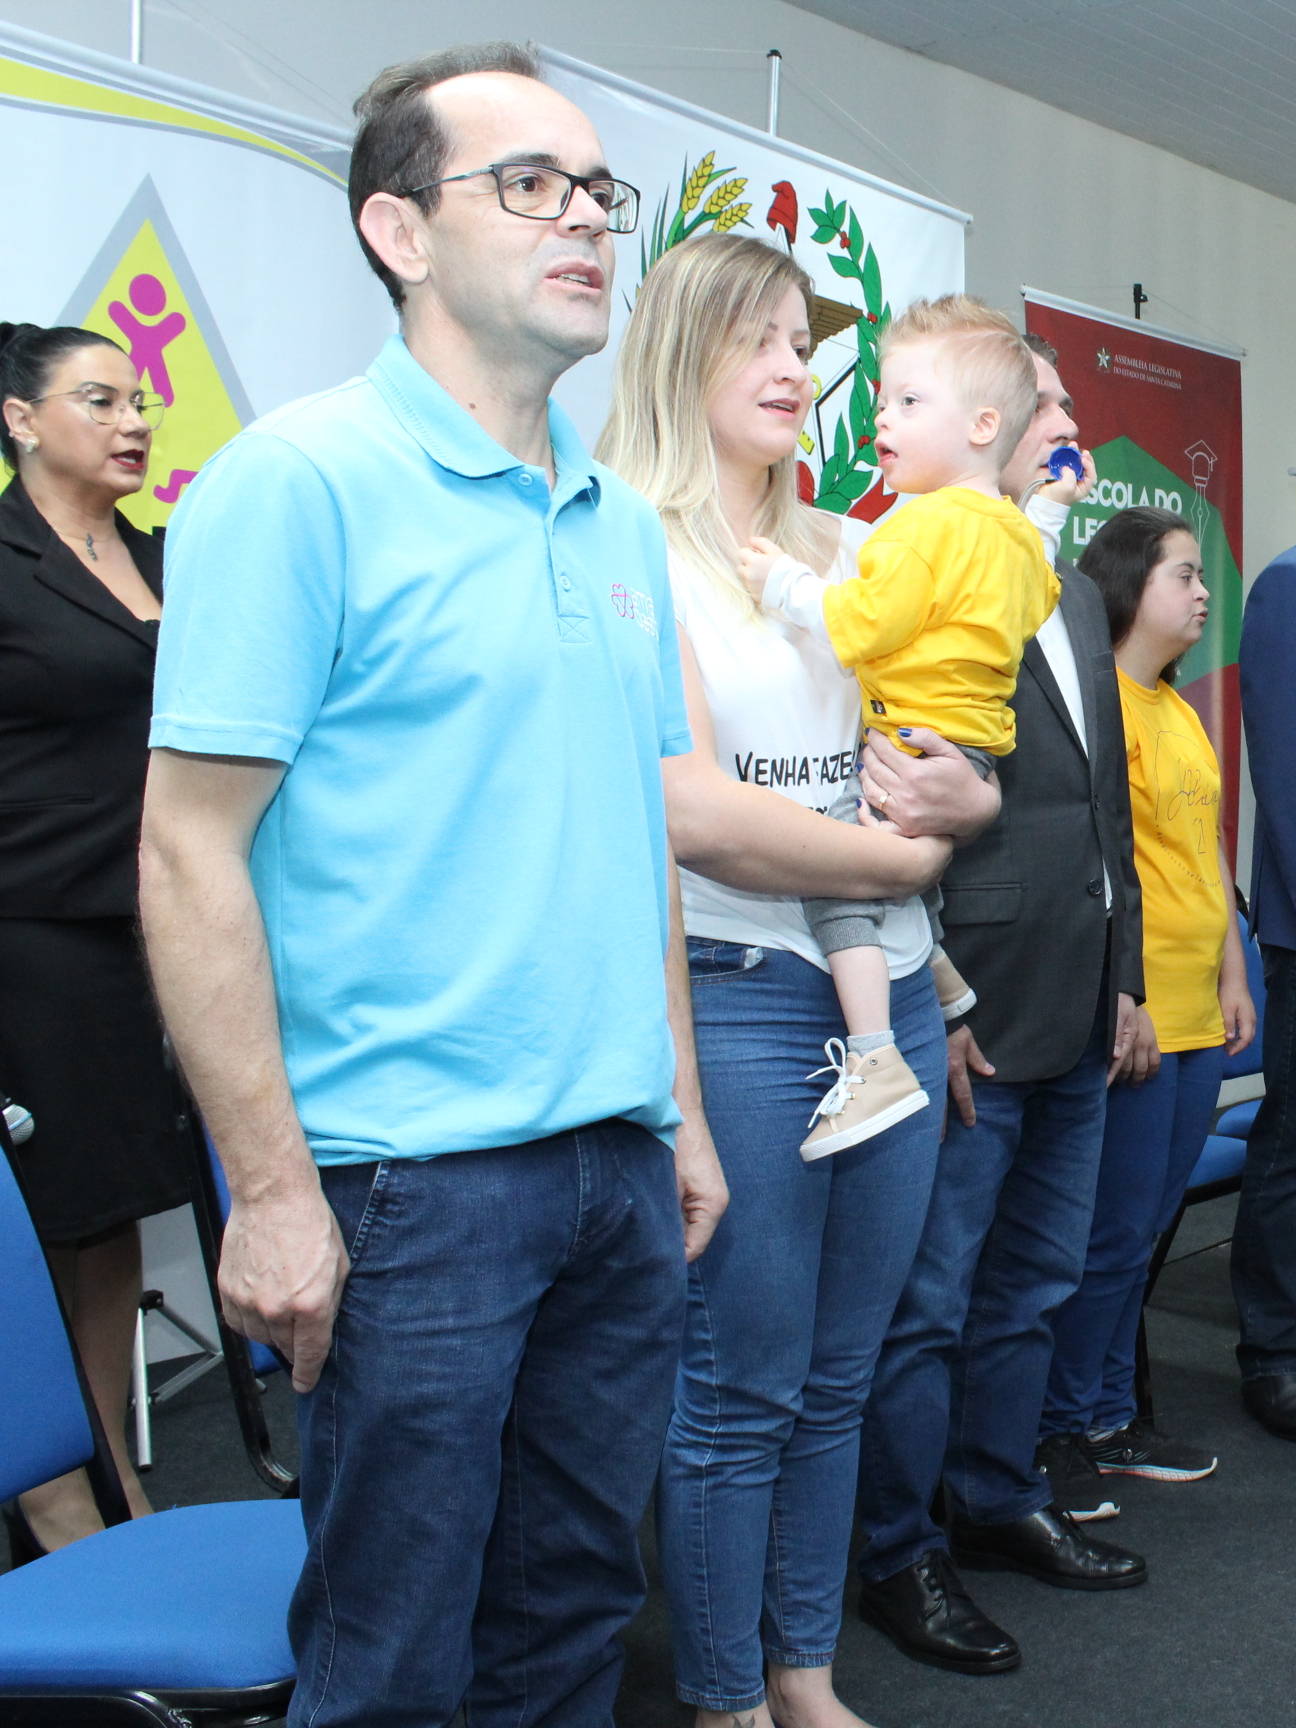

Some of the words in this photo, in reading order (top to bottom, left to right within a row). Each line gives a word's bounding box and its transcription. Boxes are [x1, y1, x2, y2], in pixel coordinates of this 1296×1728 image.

[1114, 354, 1148, 371] ASSEMBLEIA
[1148, 363, 1182, 379] LEGISLATIVA
[1080, 478, 1150, 509] SCOLA
[1154, 488, 1182, 515] DO
[1073, 516, 1107, 545] LE
[735, 751, 810, 788] VENHA
